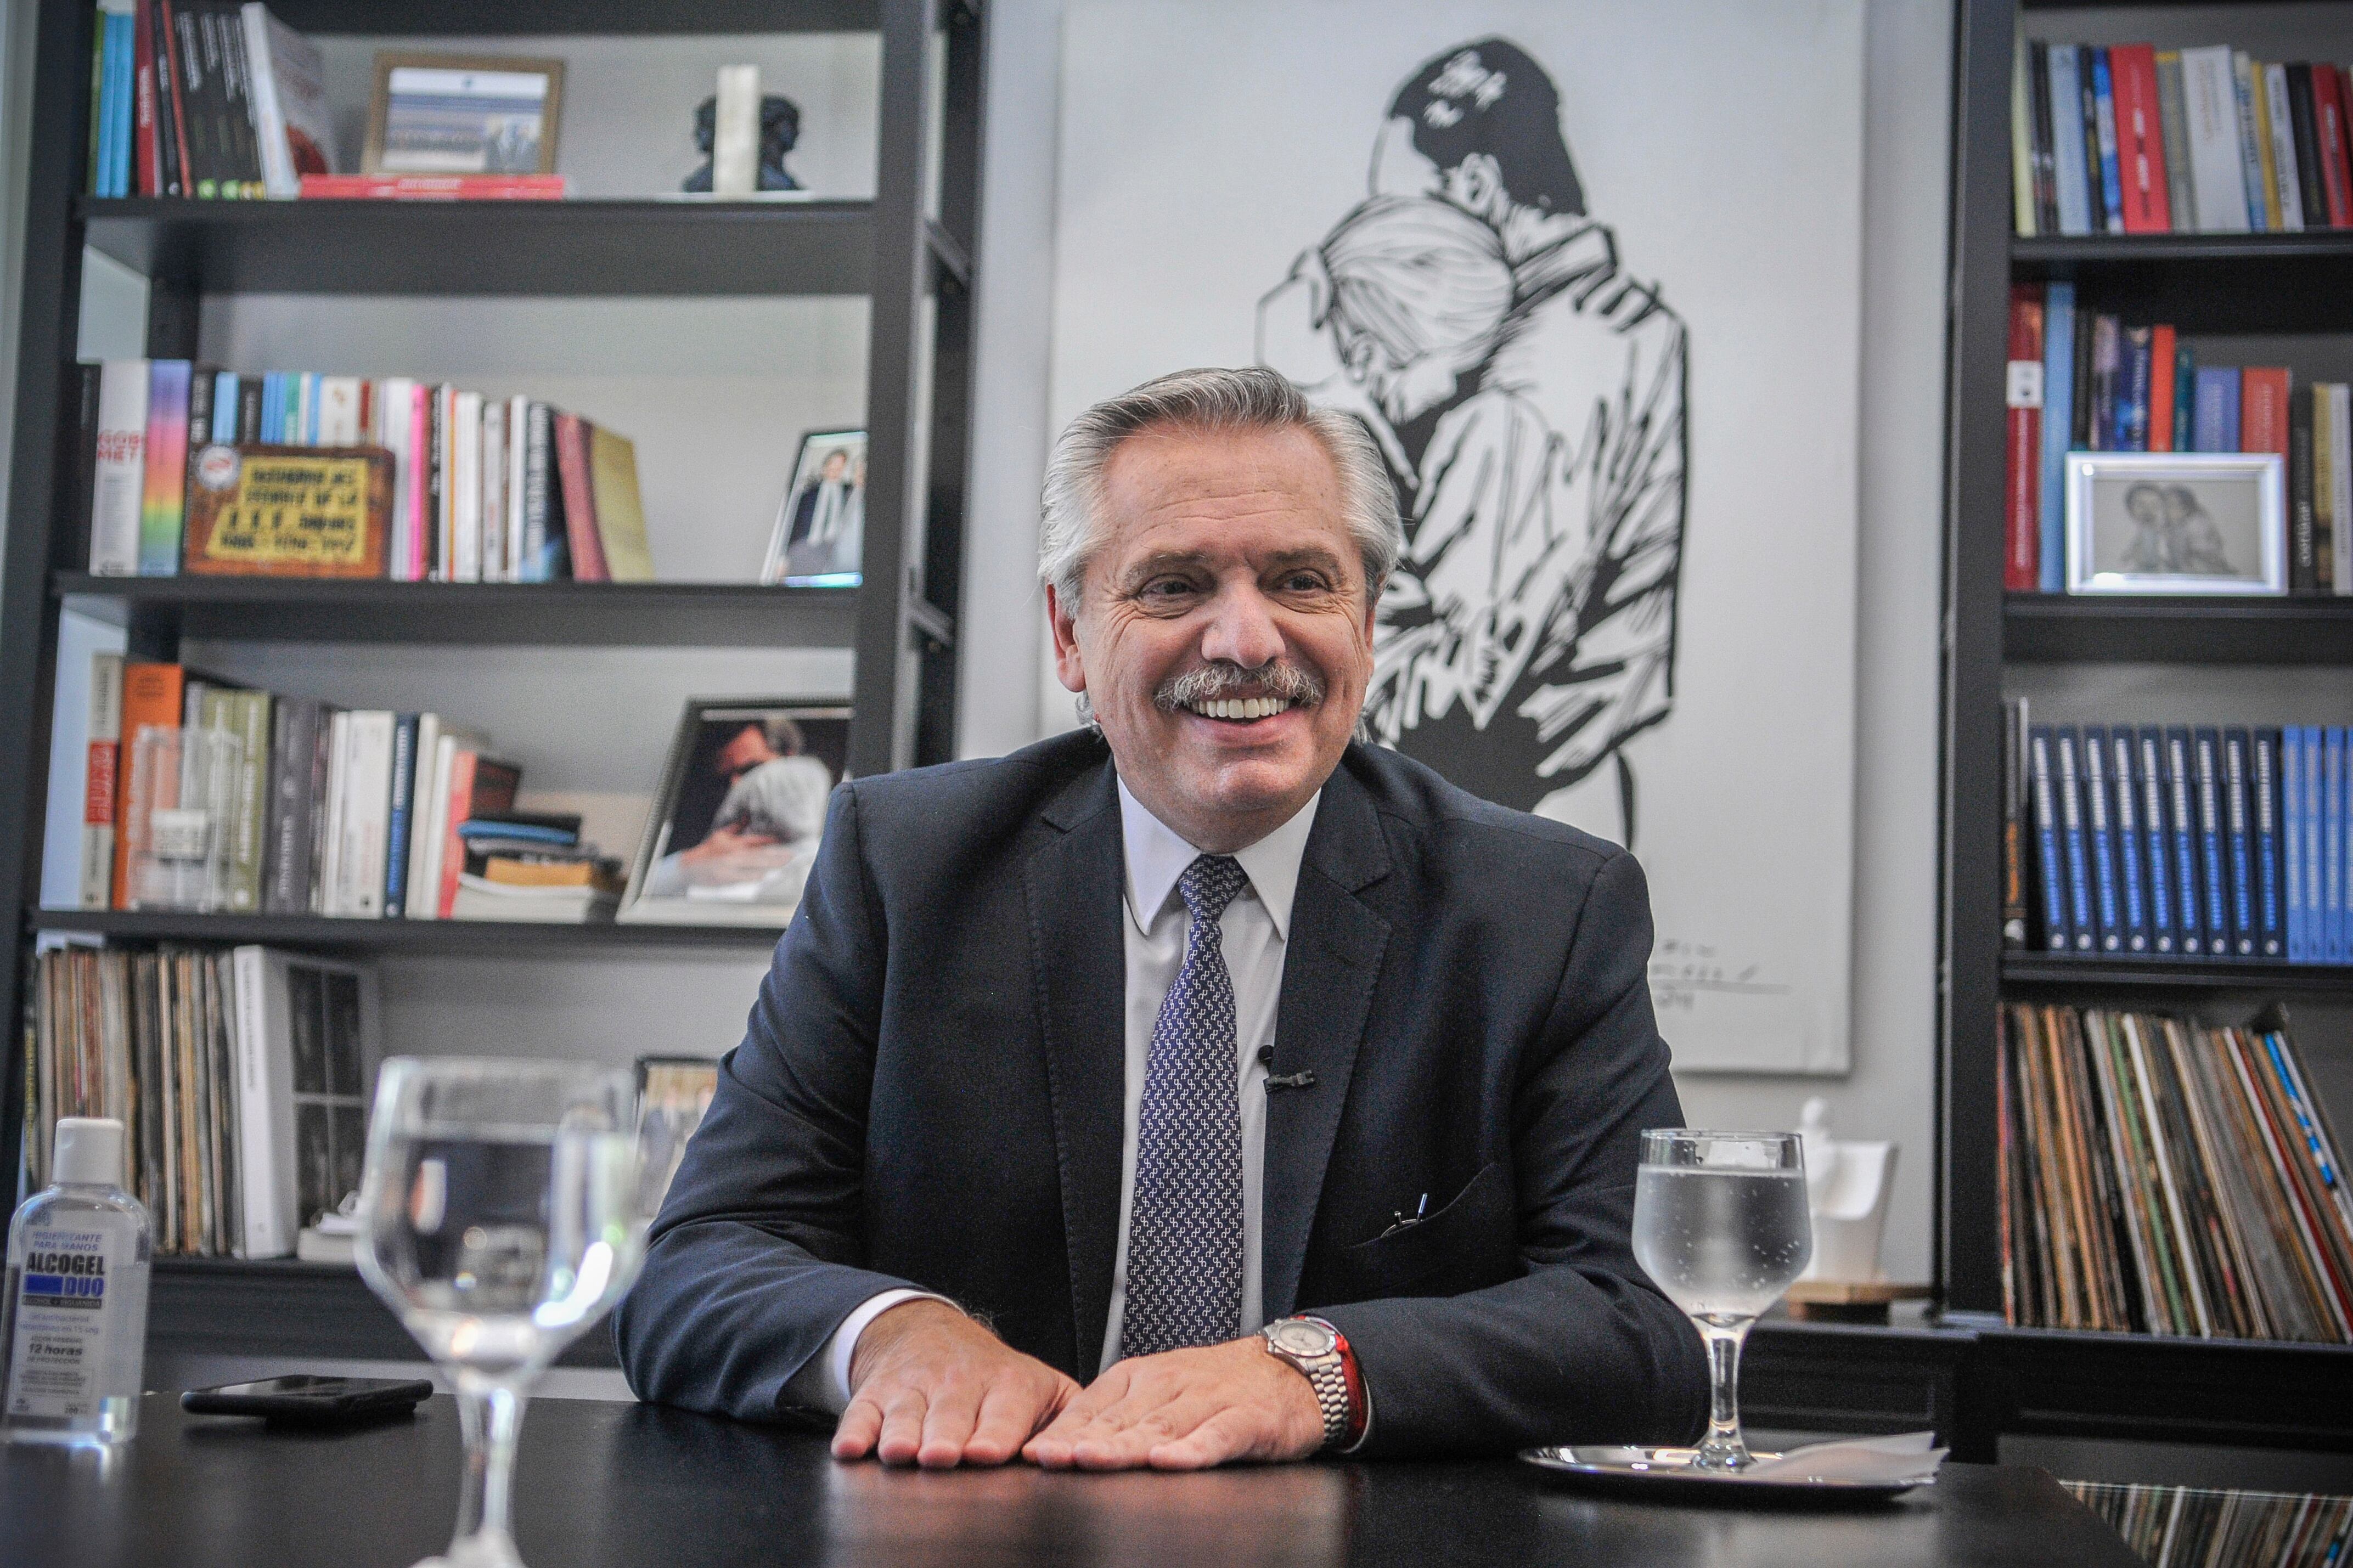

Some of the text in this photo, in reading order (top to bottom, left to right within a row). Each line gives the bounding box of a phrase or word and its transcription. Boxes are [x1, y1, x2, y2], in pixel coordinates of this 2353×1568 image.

[34, 1240, 57, 1249] PARA
[61, 1242, 99, 1251] MANOS
[26, 1252, 105, 1276] ALCOGEL
[64, 1276, 104, 1297] DUO
[29, 1344, 83, 1356] 12 horas
